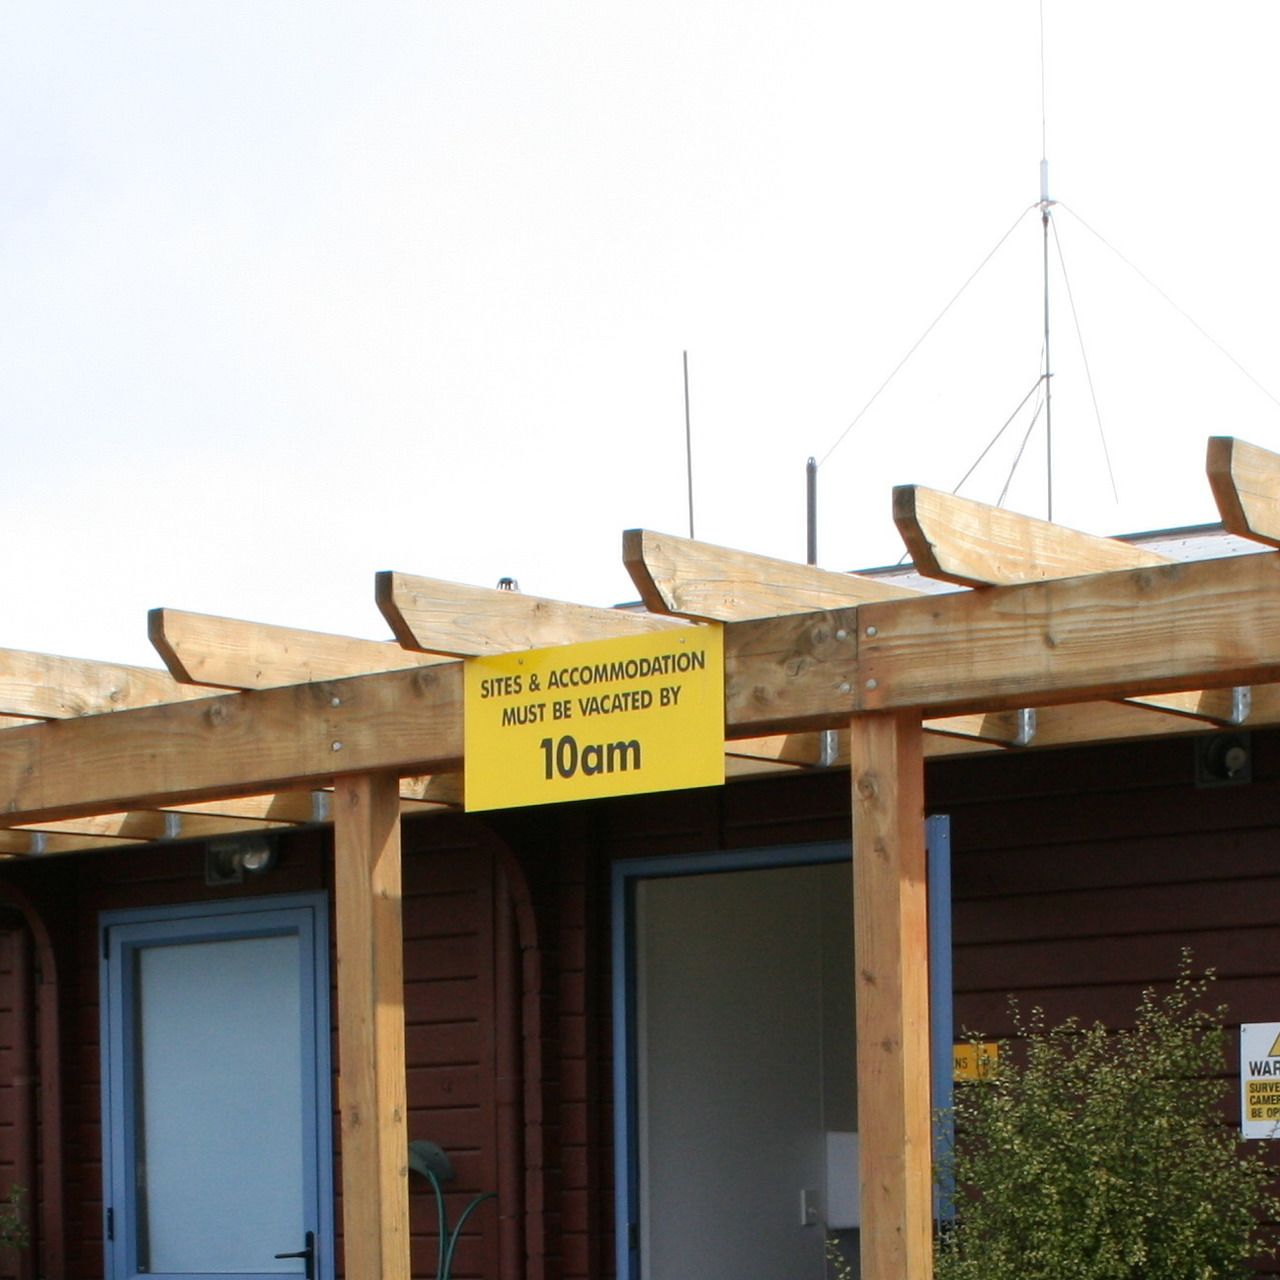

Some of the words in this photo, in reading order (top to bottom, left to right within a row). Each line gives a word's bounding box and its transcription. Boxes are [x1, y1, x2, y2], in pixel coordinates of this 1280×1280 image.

[480, 675, 522, 699] SITES
[528, 673, 541, 693] &
[548, 650, 706, 691] ACCOMMODATION
[502, 703, 546, 727] MUST
[553, 700, 572, 721] BE
[578, 690, 653, 717] VACATED
[660, 685, 682, 707] BY
[540, 735, 641, 780] 10am
[1251, 1107, 1263, 1118] BE
